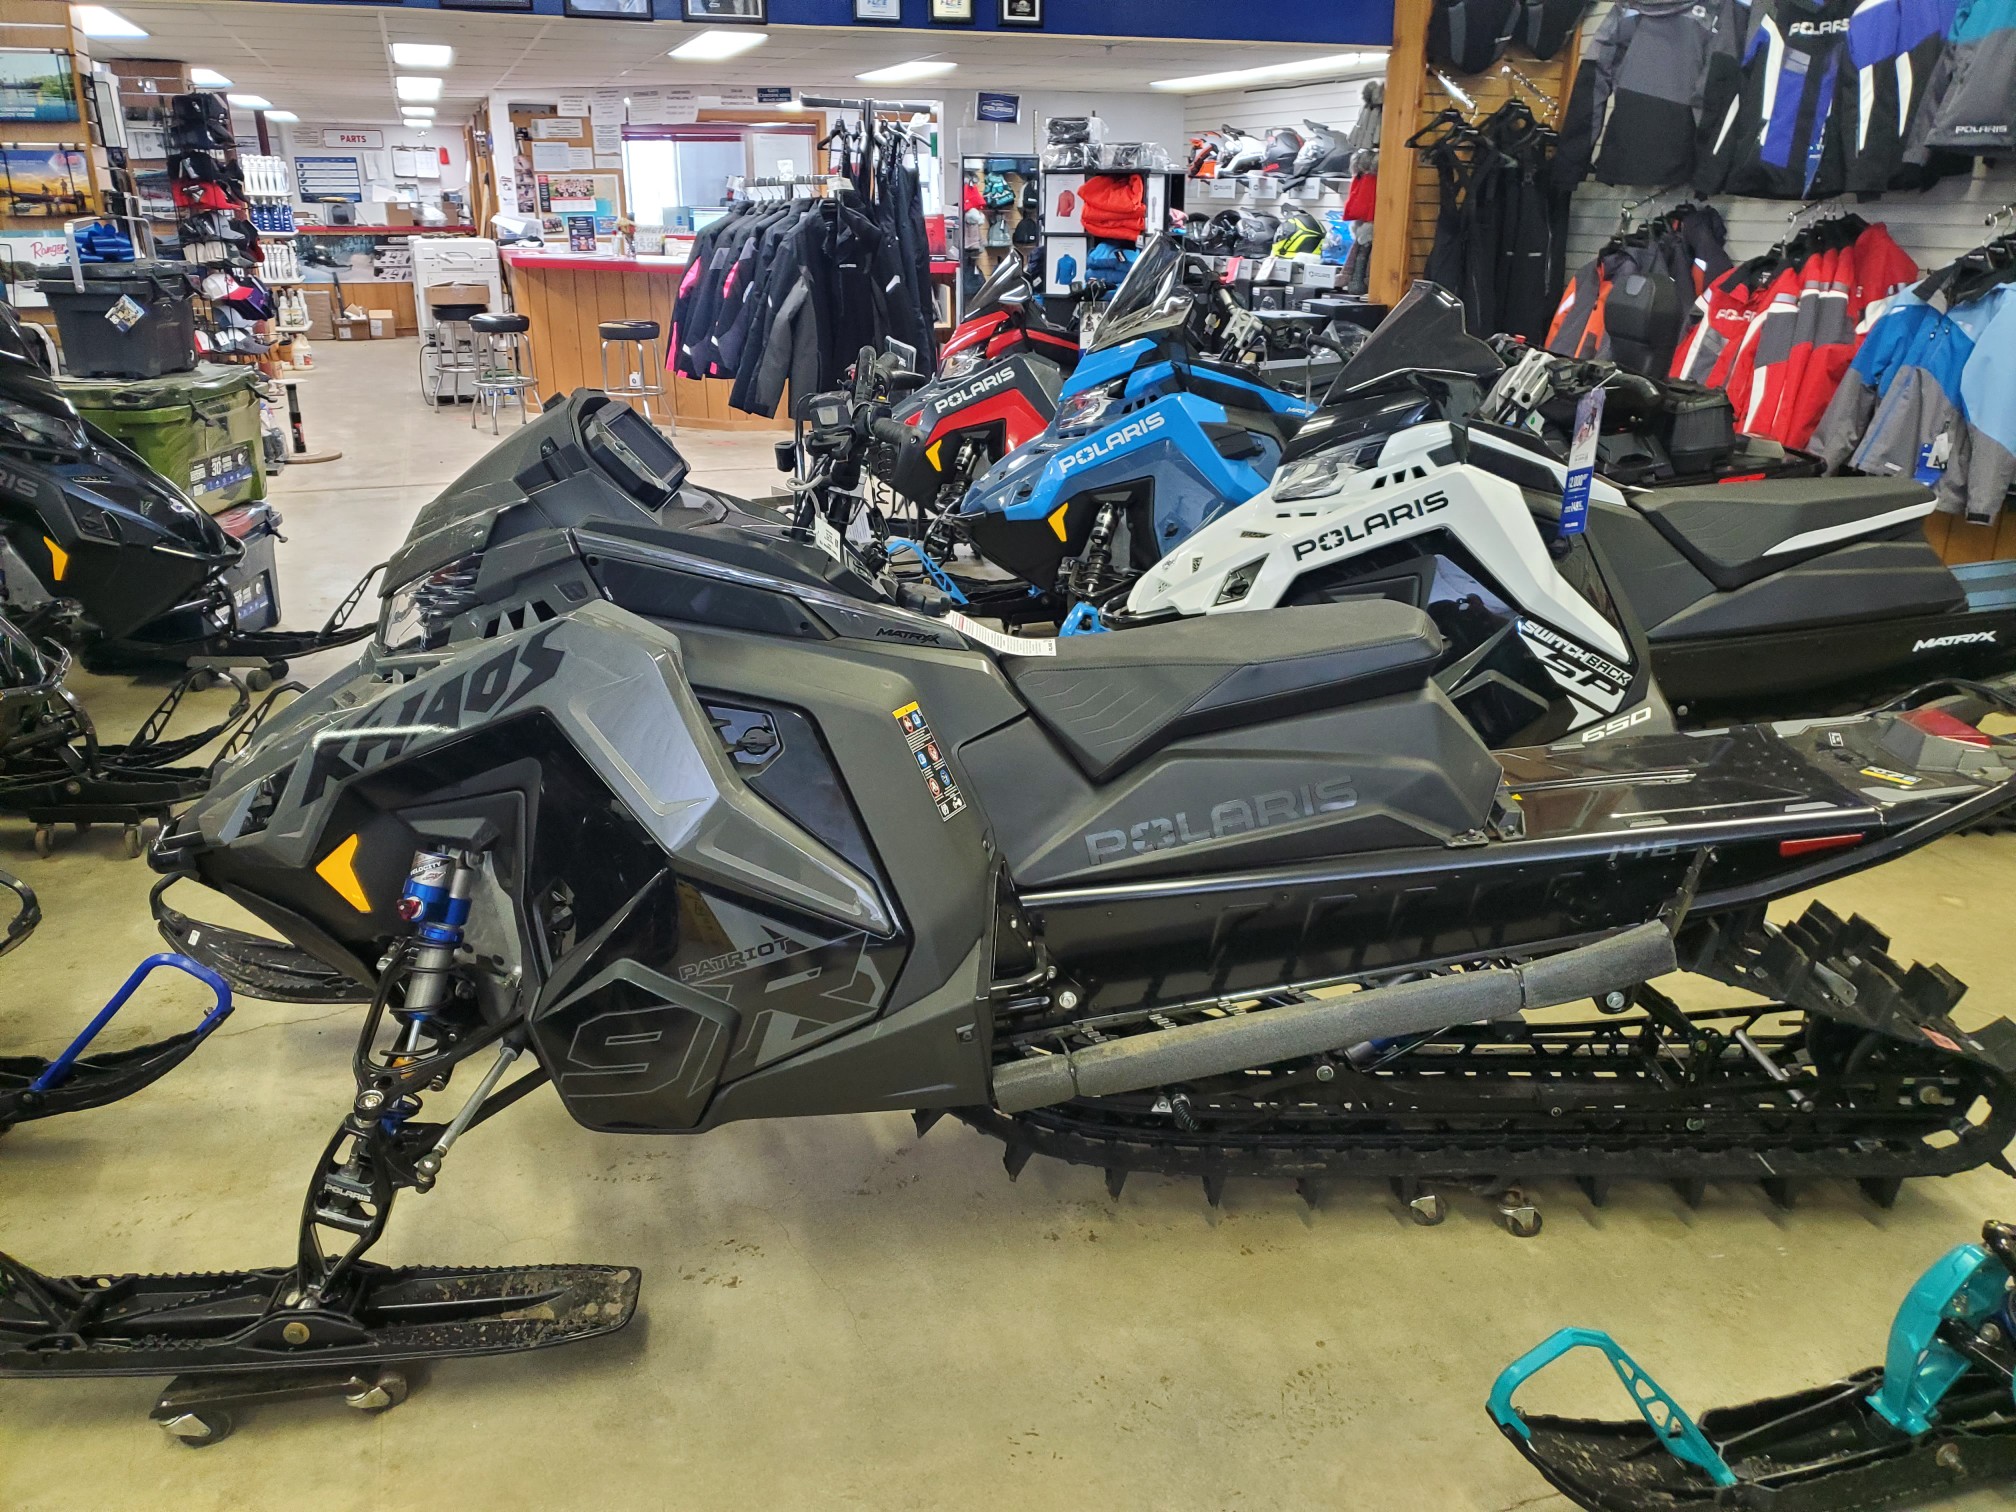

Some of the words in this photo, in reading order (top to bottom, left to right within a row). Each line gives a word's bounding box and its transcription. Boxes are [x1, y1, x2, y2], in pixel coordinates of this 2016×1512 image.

[340, 135, 367, 143] PARTS
[1955, 125, 2008, 134] POLARIS
[31, 241, 66, 259] Ranger
[935, 366, 1016, 414] POLARIS
[1058, 411, 1165, 474] POLARIS
[1292, 490, 1449, 562] POLARIS
[875, 627, 941, 645] MATRYX
[1912, 630, 1997, 652] MATRYX
[1520, 620, 1633, 687] SWITCHBACK
[1582, 706, 1652, 742] 650
[1084, 775, 1359, 866] POLARIS
[410, 860, 441, 876] VELOCITY
[678, 935, 792, 982] PATRIOT
[324, 1183, 371, 1203] POLARIS
